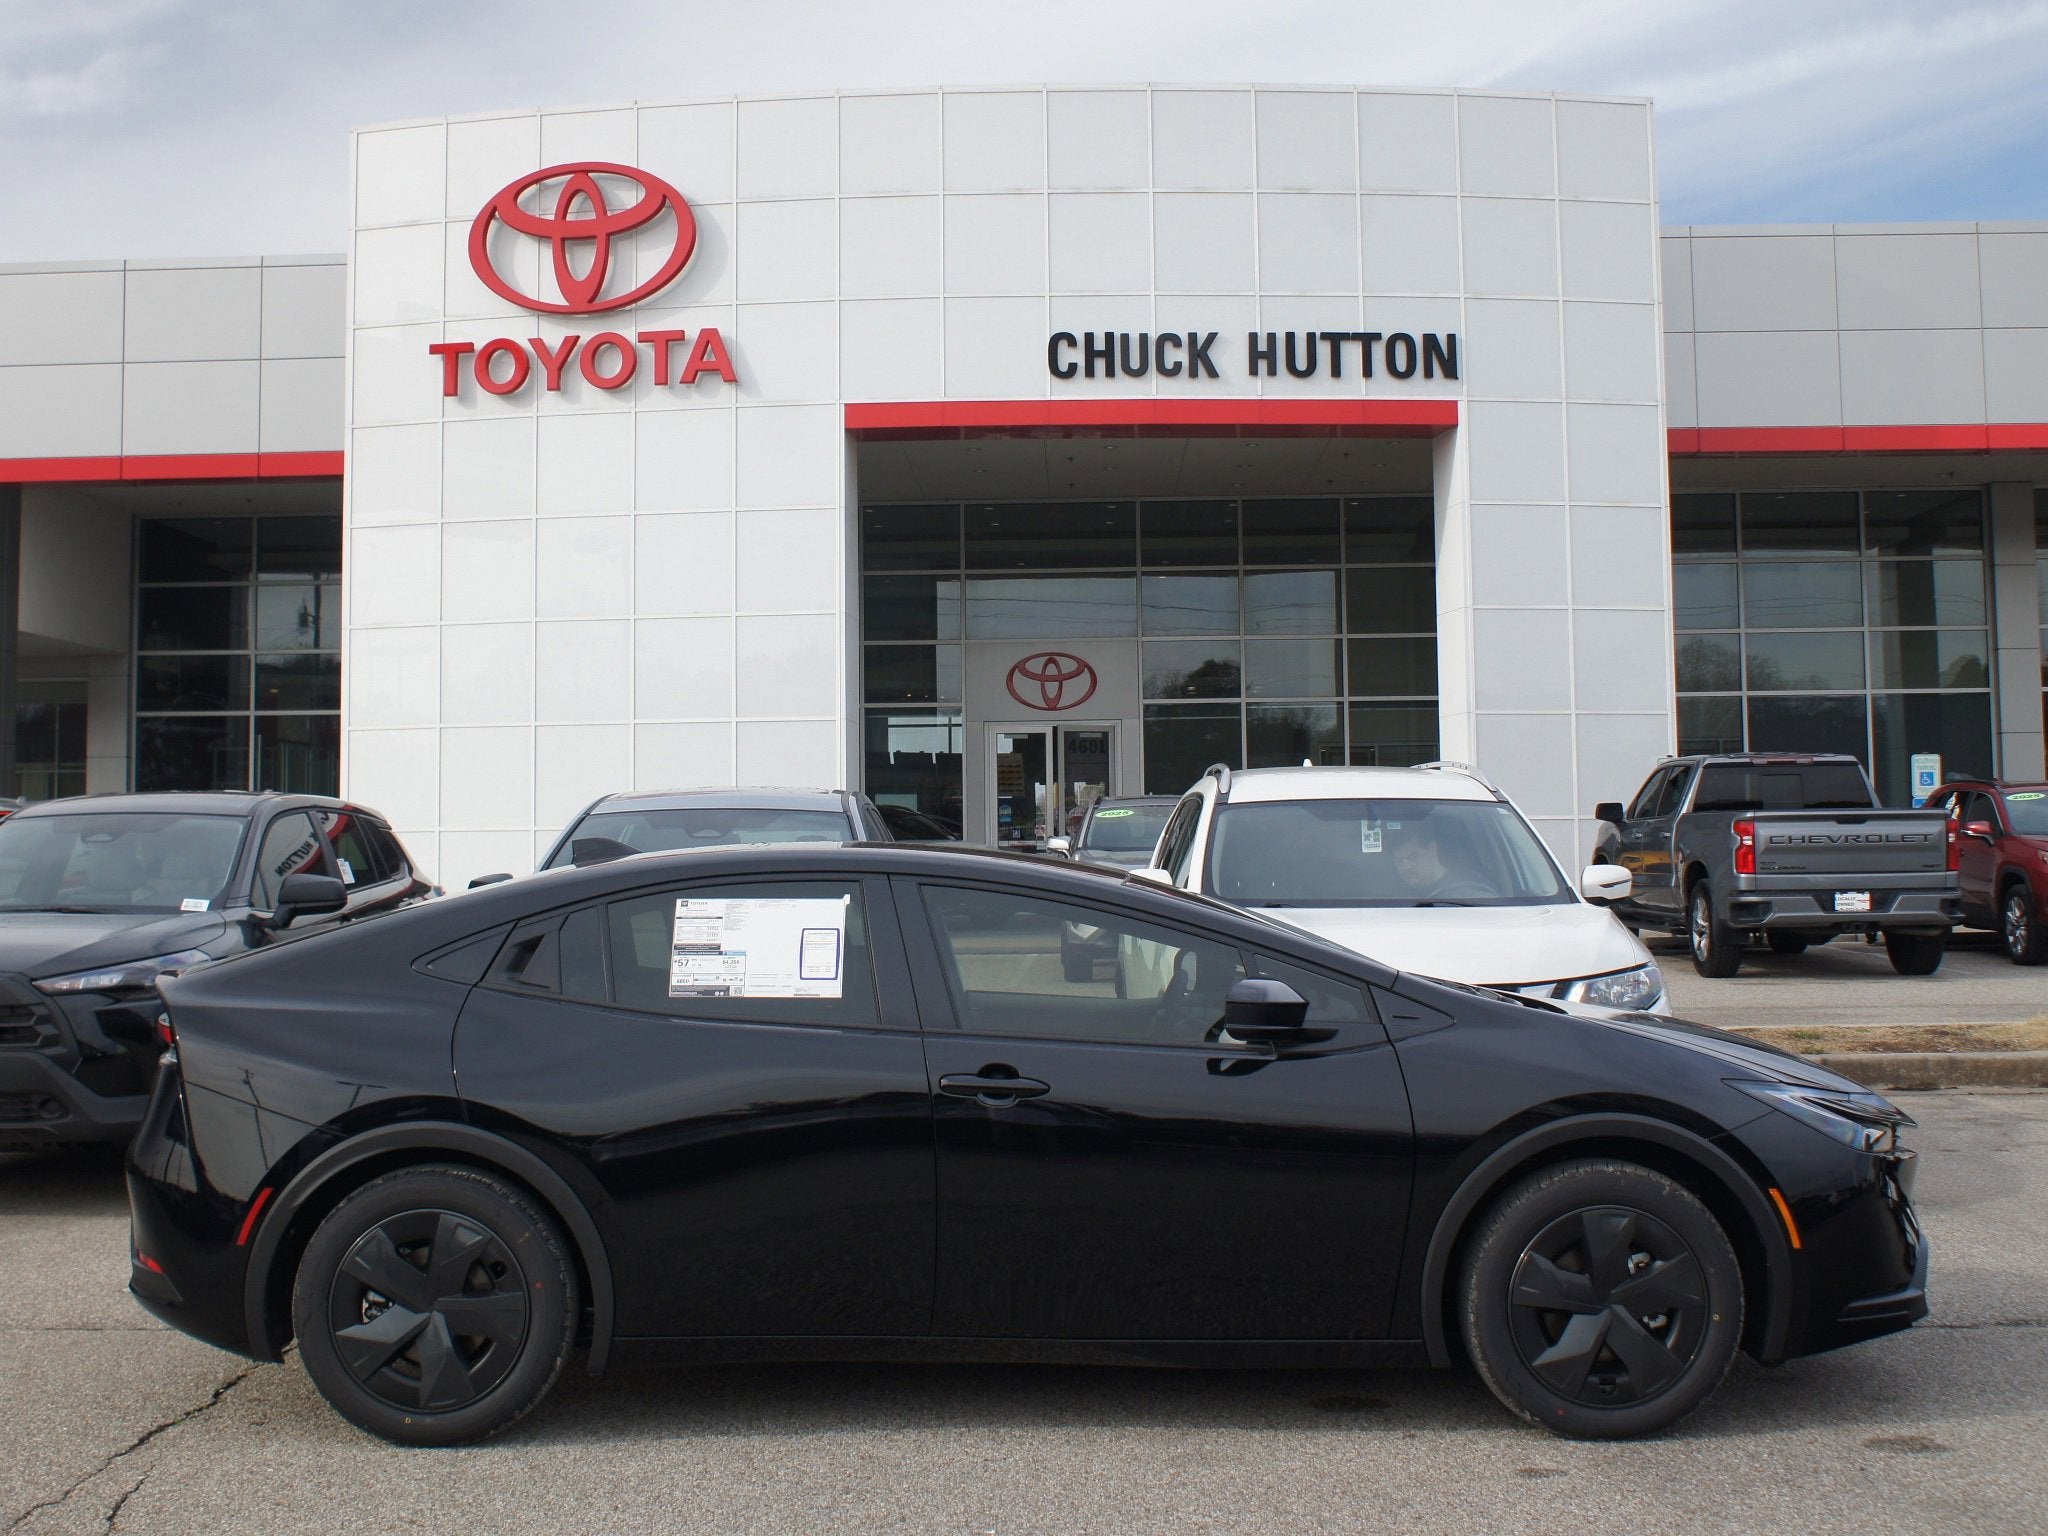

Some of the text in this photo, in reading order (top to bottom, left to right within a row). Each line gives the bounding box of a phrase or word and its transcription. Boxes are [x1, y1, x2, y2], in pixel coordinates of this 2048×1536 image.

[429, 328, 738, 397] TOYOTA
[1047, 331, 1459, 380] CHUCK HUTTON
[1068, 738, 1105, 754] 4601
[1769, 833, 1934, 846] CHEVROLET
